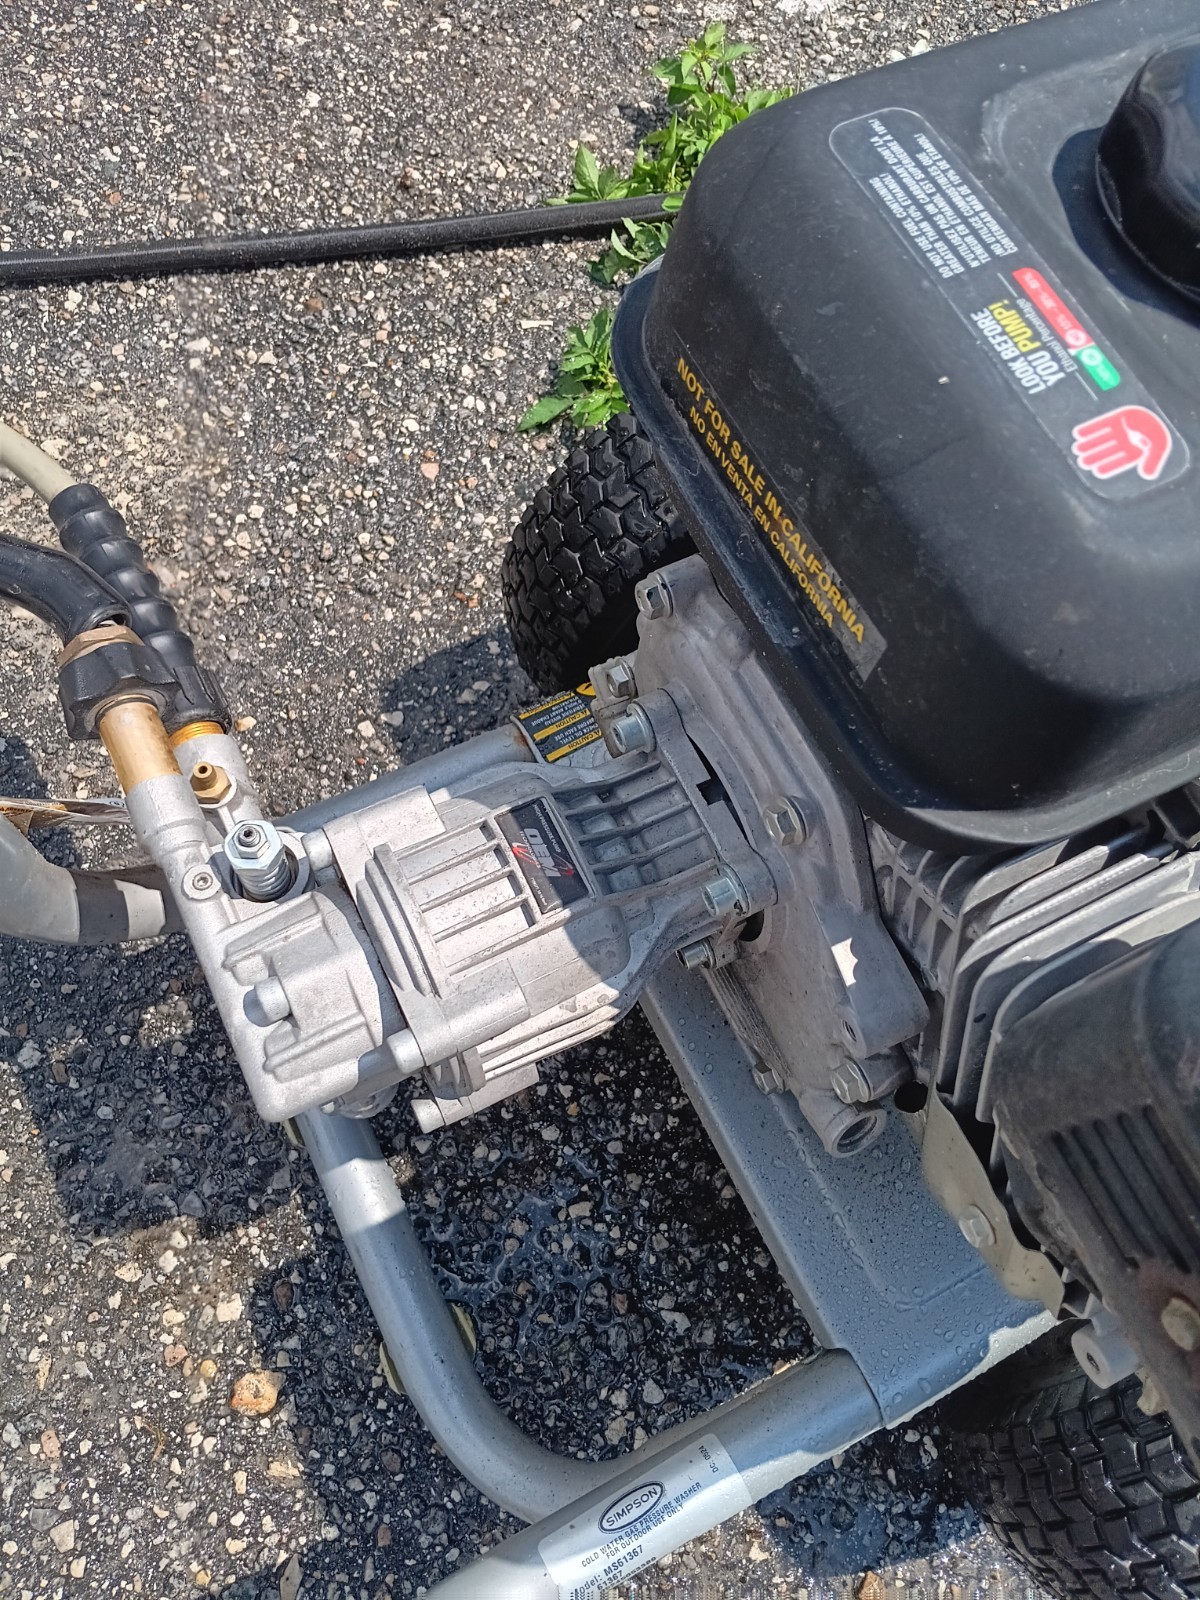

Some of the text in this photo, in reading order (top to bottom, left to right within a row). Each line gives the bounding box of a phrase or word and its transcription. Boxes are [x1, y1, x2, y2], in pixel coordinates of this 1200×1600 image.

[868, 117, 888, 135] 10%!
[915, 150, 933, 167] QUE
[936, 159, 950, 171] DE
[919, 179, 936, 194] EST
[927, 163, 975, 219] COMBUSTIBLES
[945, 169, 963, 185] 10%
[957, 184, 972, 196] DE
[870, 136, 981, 268] N'UTILISEZ PAS UN CARBURANT DONT LA
[869, 176, 954, 279] DO NOT USE FUEL CONTAINING
[880, 172, 965, 274] GREATER THAN 10% ETHANOL!
[955, 223, 970, 236] EN
[968, 215, 996, 245] UTILICE
[979, 209, 1018, 254] CONTENGAN
[963, 234, 991, 263] TENEUR
[988, 299, 1066, 387] YOU PUMP!
[1016, 296, 1078, 373] Ethanol Percentage
[970, 307, 1048, 395] LOOK BEFORE
[678, 357, 865, 644] NOT FOR SALE IN CALIFORNIA
[690, 406, 834, 628] NO EN VENTA EN CALIFORNIA
[555, 713, 581, 729] CAUTION
[560, 722, 599, 745] CHECK OIL LEVEL
[564, 726, 577, 736] EACH
[554, 733, 564, 741] USE
[568, 733, 594, 749] CAUTION
[532, 804, 562, 854] HIGH PRESSURE PUMP
[521, 828, 563, 878] OEM
[605, 1487, 659, 1527] SIMPSON
[581, 1482, 702, 1567] COLD WATER GAS PRESSURE WASHER
[605, 1503, 685, 1559] FOR OUTDOOR USE ONLY
[603, 1545, 645, 1576] MS61367
[596, 1570, 624, 1591] 61367
